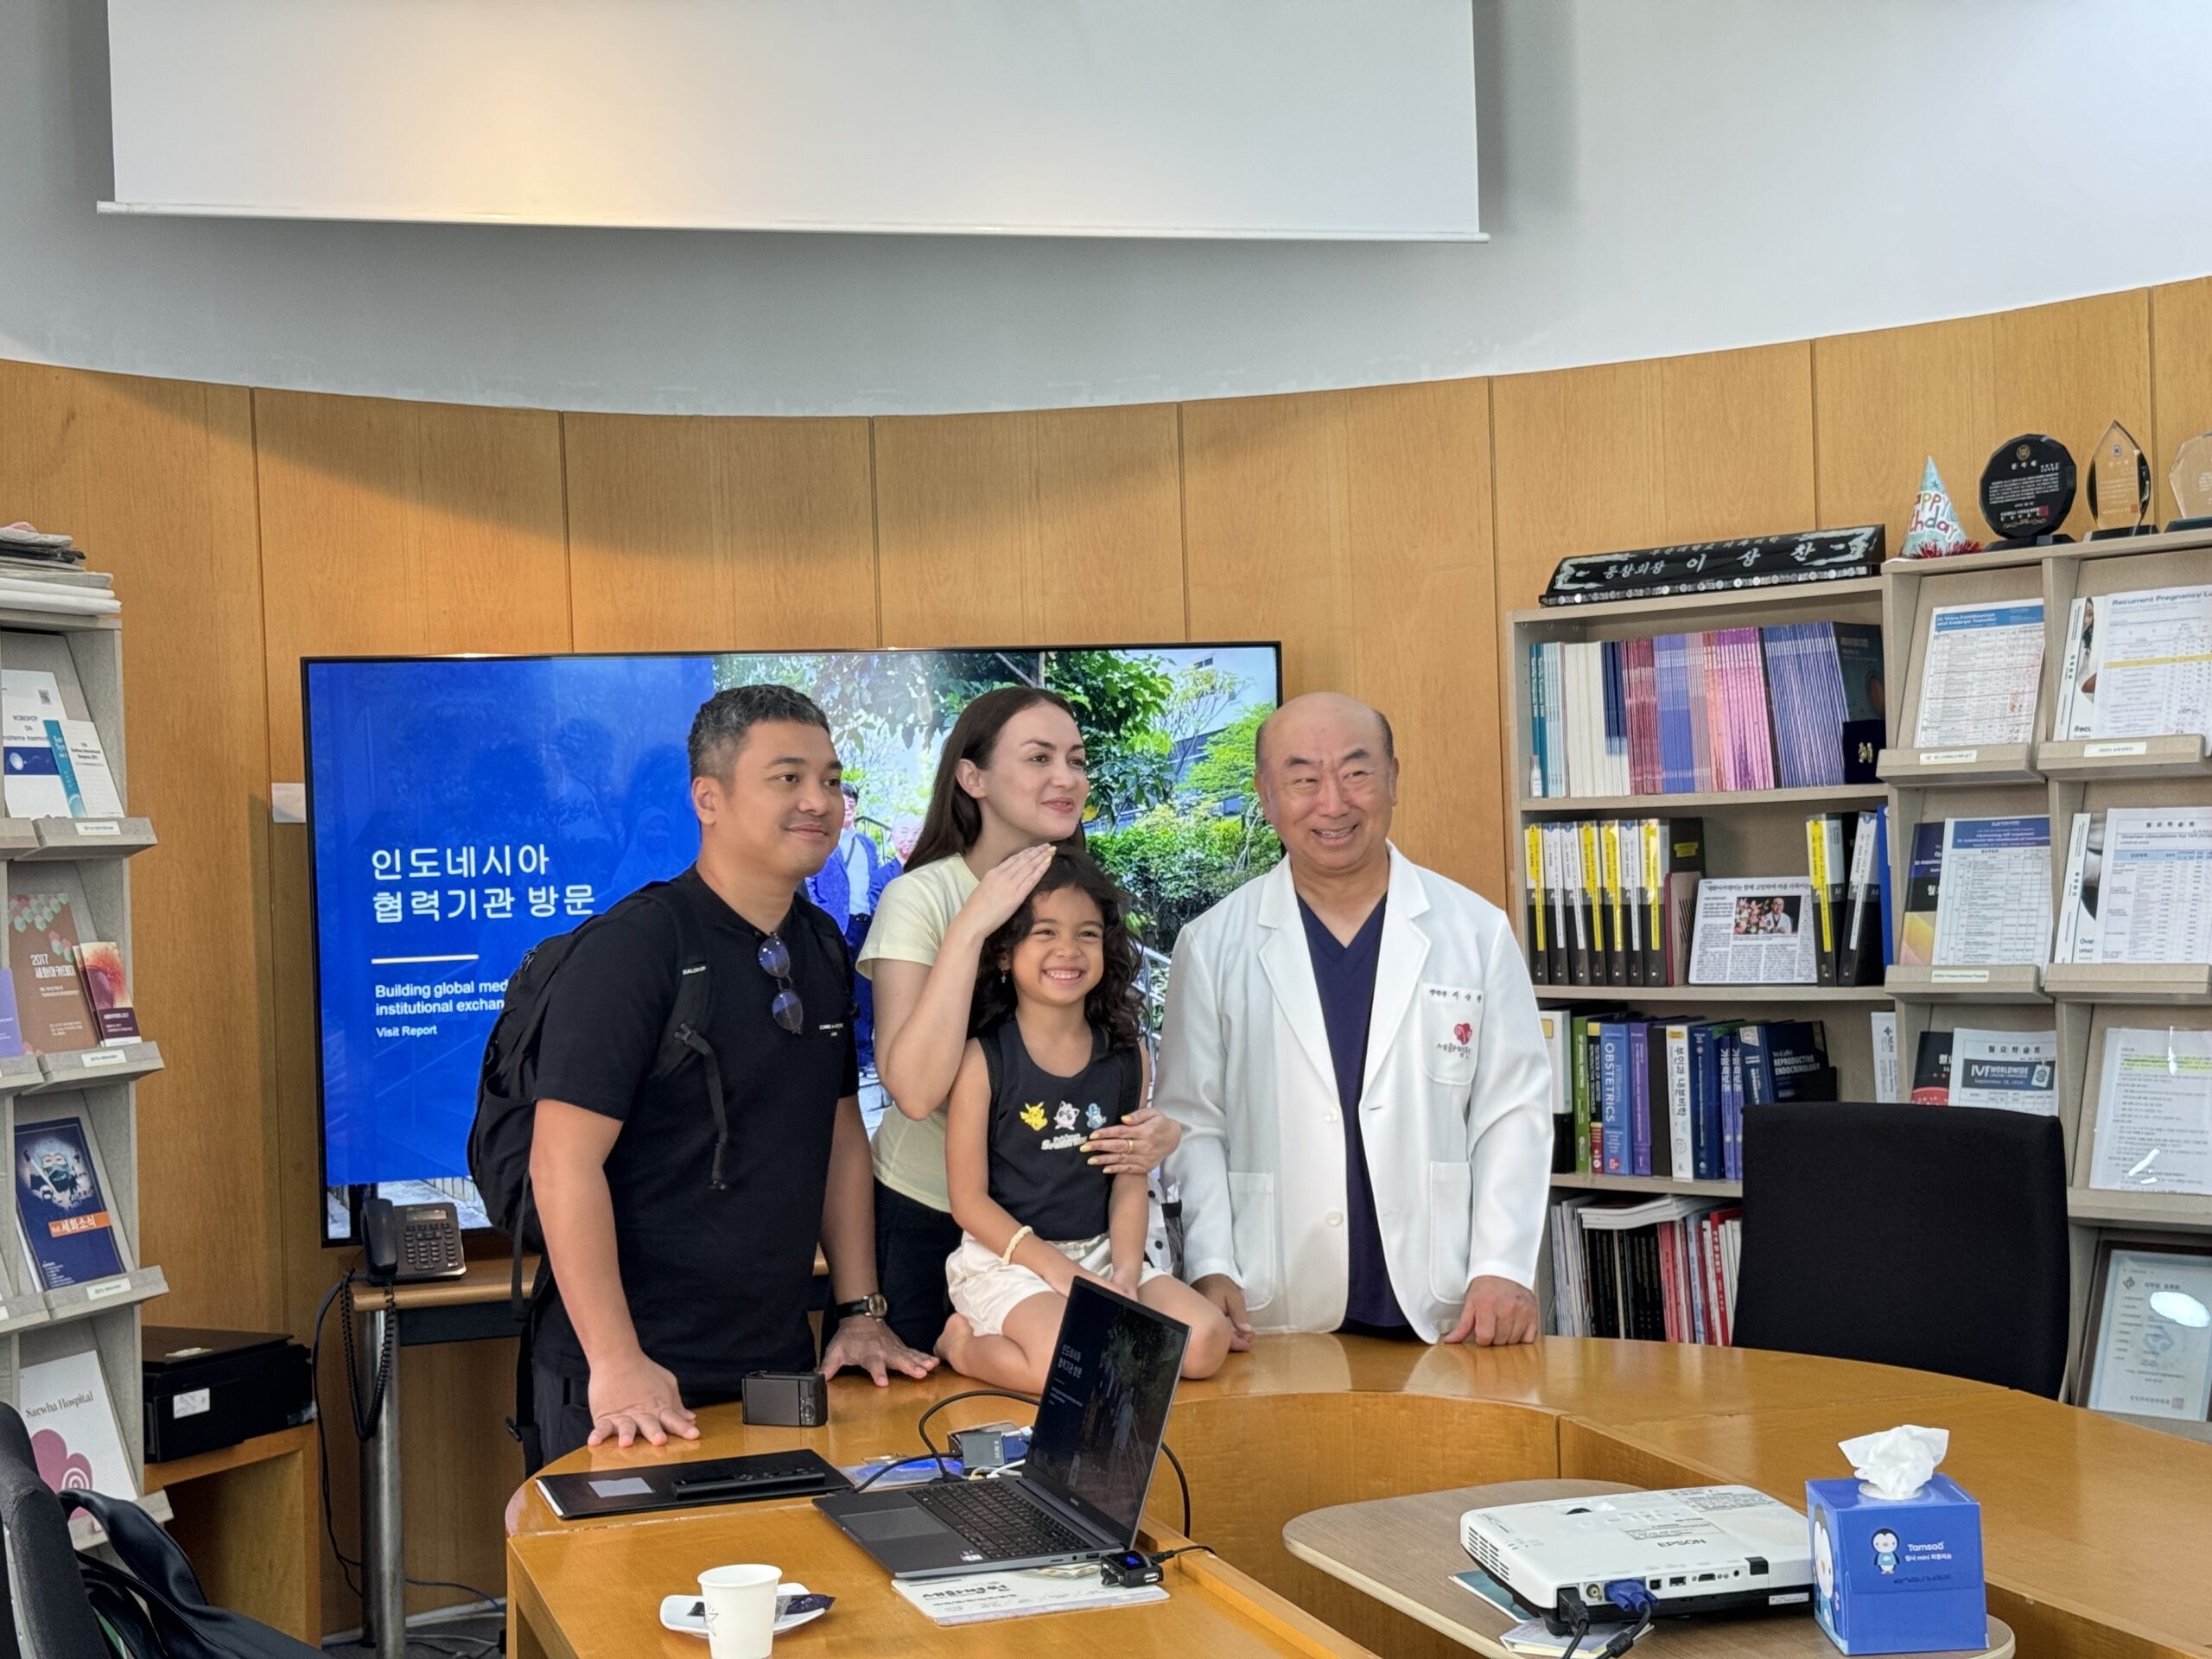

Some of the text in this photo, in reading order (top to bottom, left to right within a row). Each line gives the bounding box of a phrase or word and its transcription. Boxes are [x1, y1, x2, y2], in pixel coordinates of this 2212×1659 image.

[1686, 553, 1707, 573] 이
[1736, 547, 1762, 568] 상
[372, 843, 550, 880] 인도네시아
[372, 884, 595, 925] 협력기관 방문
[30, 953, 48, 966] 2017
[376, 978, 509, 1001] Building global med
[376, 996, 505, 1016] institutional exchan
[377, 1025, 437, 1039] Visit Report
[1773, 1054, 1815, 1067] REPRODUCTIVE
[1990, 1065, 2029, 1074] WORLDWIDE
[1605, 1043, 1615, 1122] OBSTETRICS
[1674, 1046, 1686, 1116] 부인과 내분비학
[57, 1389, 94, 1408] Hospital
[1657, 1538, 1707, 1548] EPSON
